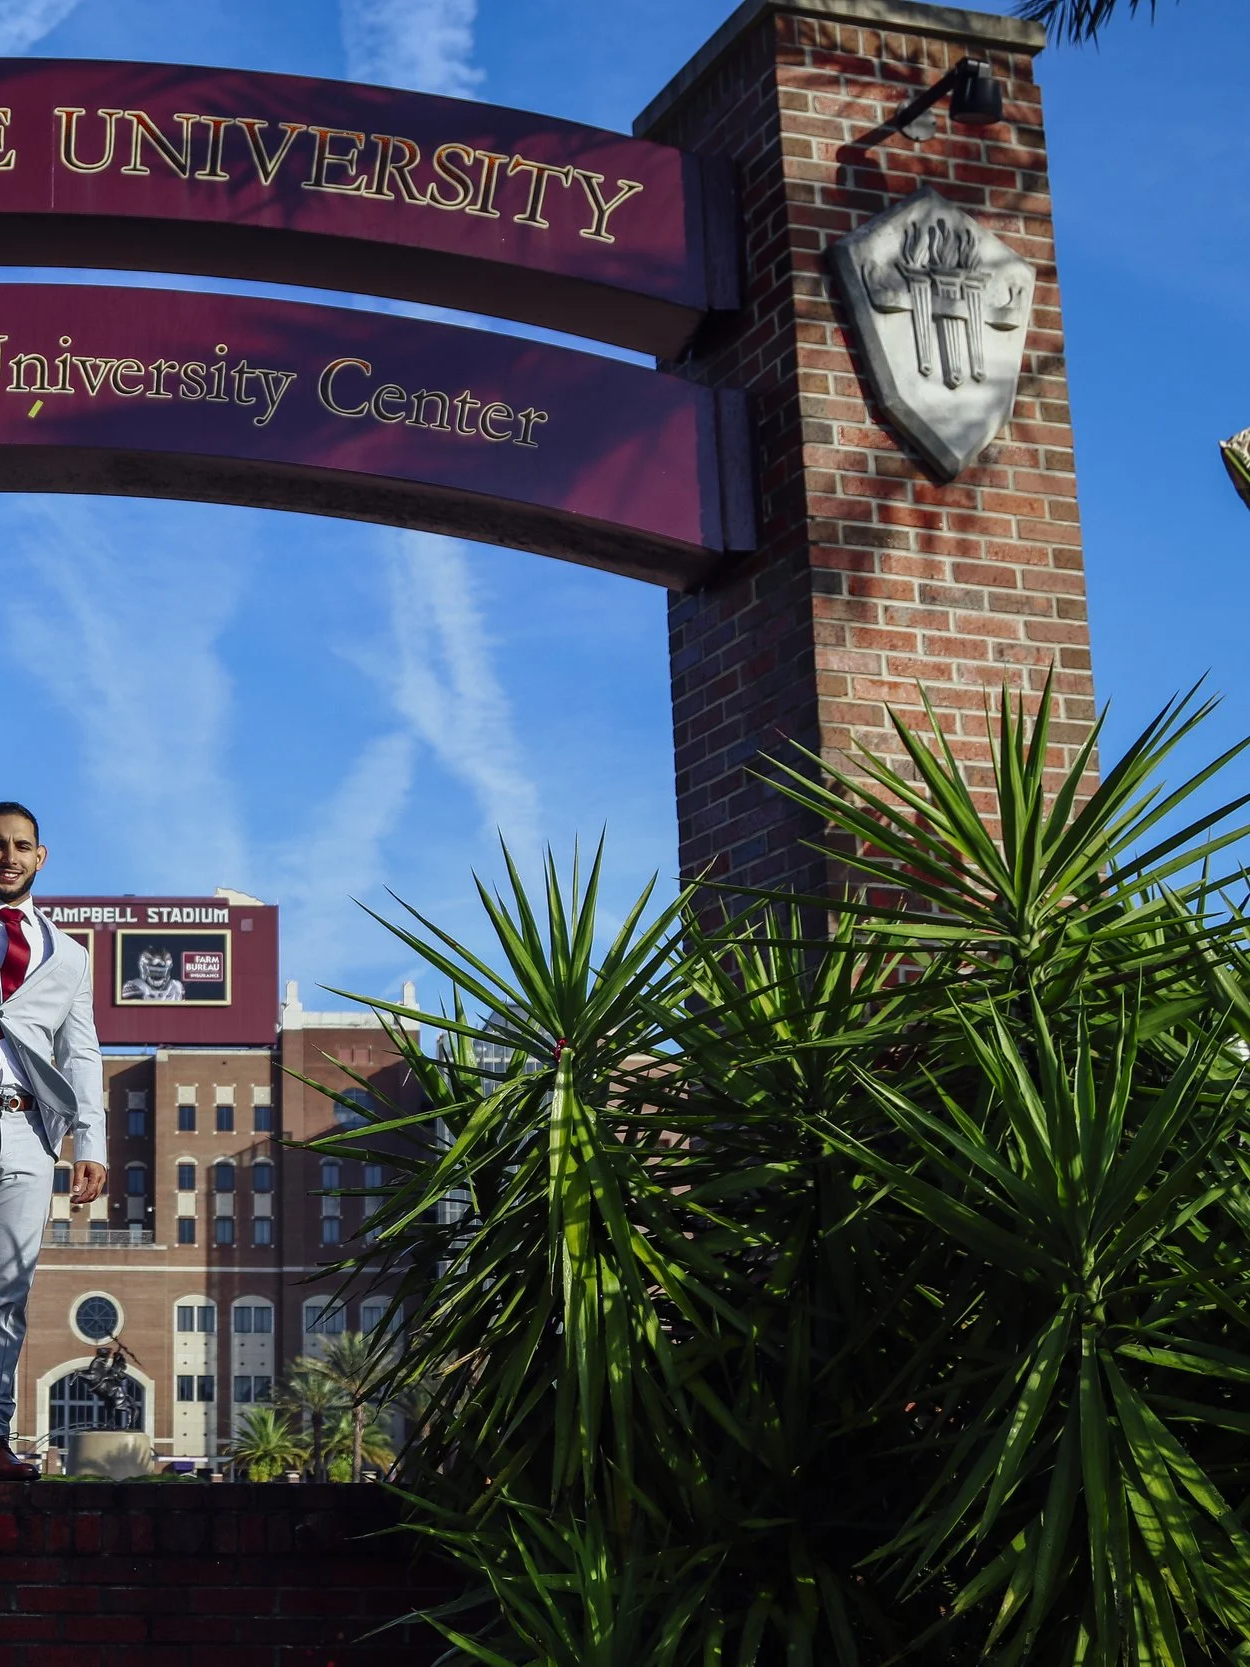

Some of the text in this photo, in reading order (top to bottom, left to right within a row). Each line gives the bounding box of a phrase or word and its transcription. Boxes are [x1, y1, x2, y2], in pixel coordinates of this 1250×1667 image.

[54, 107, 644, 244] UNIVERSITY
[318, 358, 550, 448] Center
[147, 907, 229, 923] STADIUM
[186, 963, 220, 971] BUREAU
[195, 955, 220, 963] FARM
